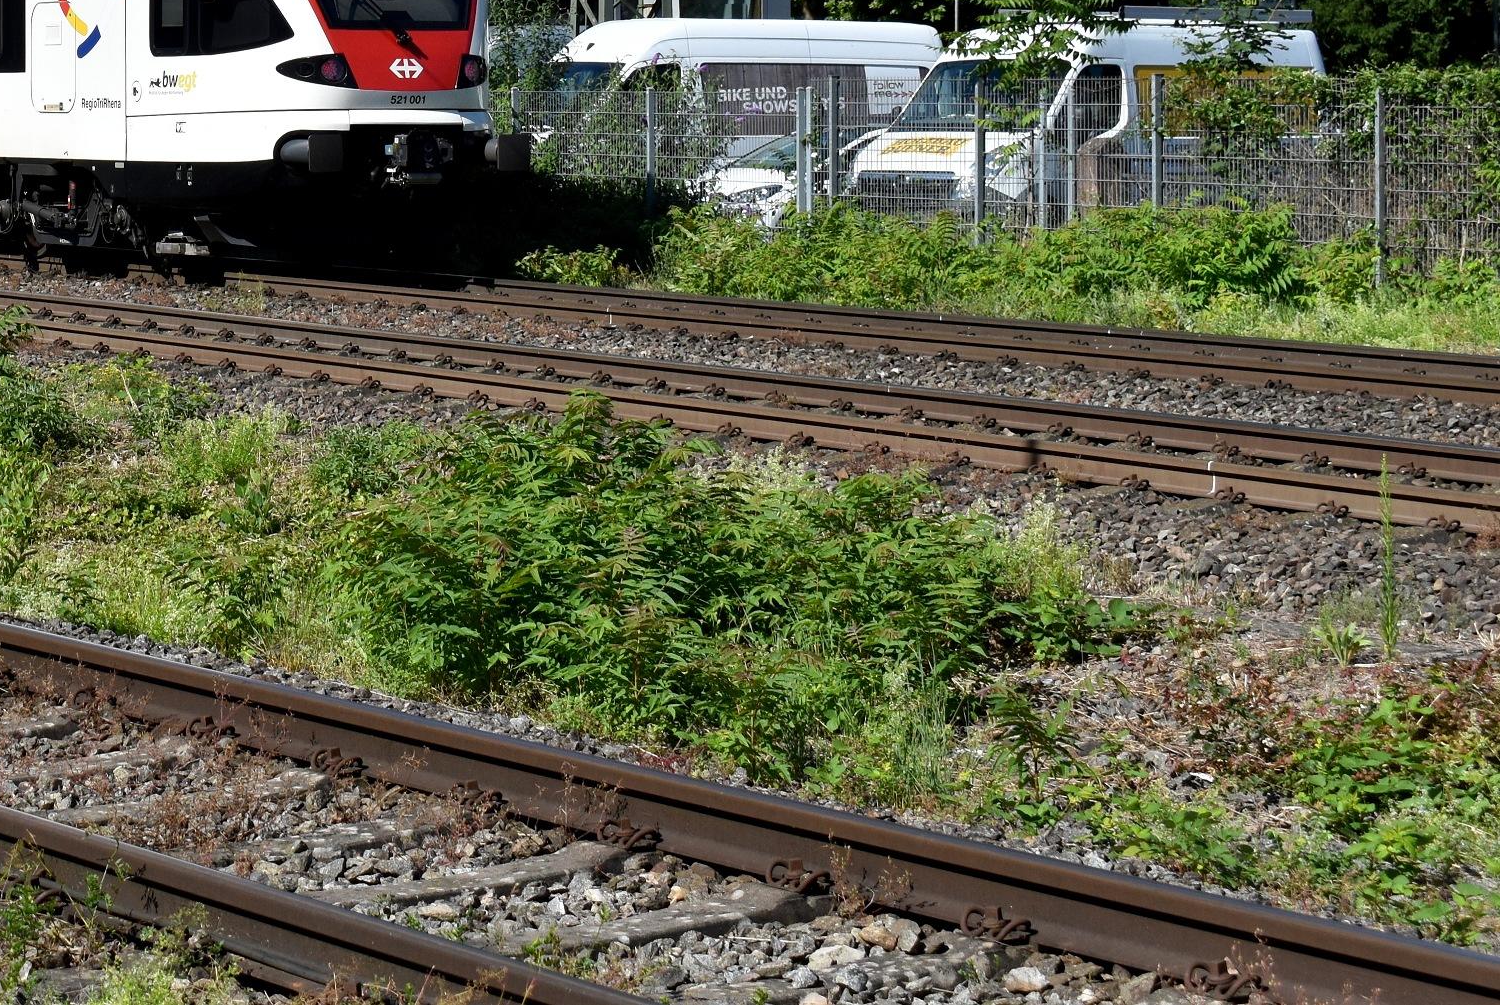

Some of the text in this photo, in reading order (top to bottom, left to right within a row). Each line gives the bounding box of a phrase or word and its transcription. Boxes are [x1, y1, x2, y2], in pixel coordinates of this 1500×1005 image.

[162, 70, 197, 93] bwegt
[390, 95, 427, 105] 521 001
[717, 86, 787, 102] BIKE UND
[81, 97, 122, 111] RegioTriRhena
